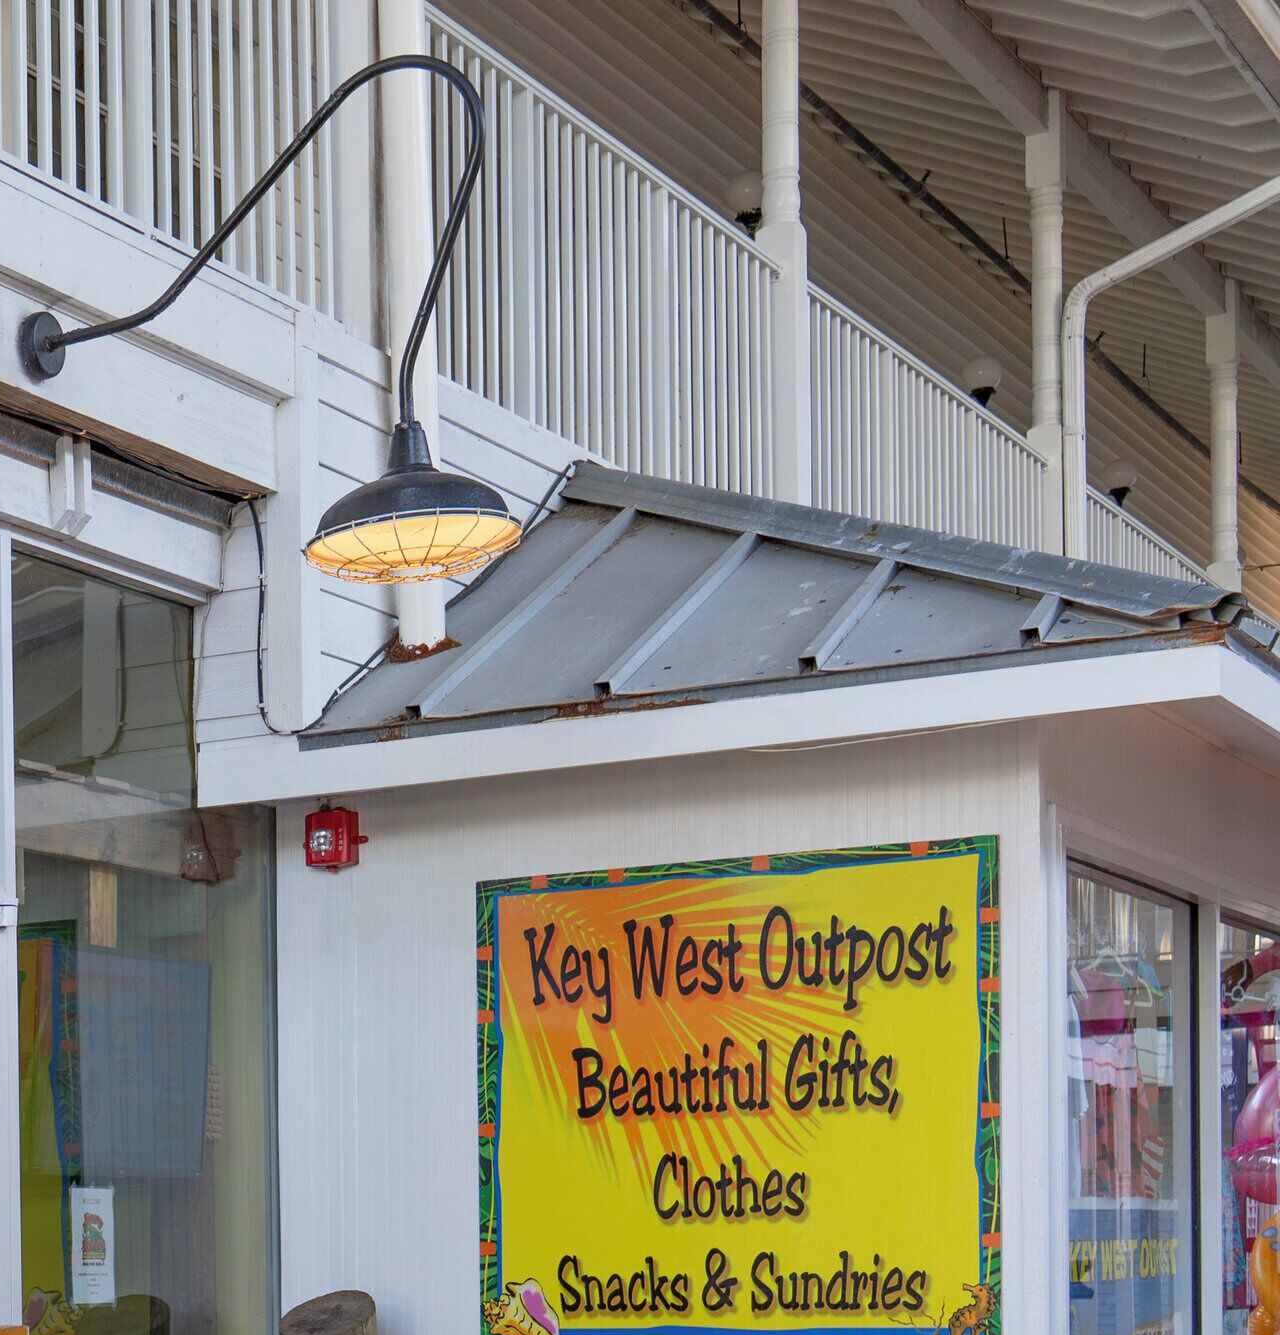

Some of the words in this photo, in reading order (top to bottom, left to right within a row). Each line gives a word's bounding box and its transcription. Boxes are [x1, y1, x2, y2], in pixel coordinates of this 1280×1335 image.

[524, 923, 611, 1023] Key
[623, 914, 743, 999] West
[760, 906, 953, 1011] Outpost
[572, 1038, 769, 1118] Beautiful
[785, 1030, 898, 1114] Gifts,
[654, 1152, 805, 1219] Clothes
[558, 1255, 688, 1313] Snacks
[702, 1248, 737, 1311] &
[751, 1251, 926, 1312] Sundries
[1069, 1240, 1097, 1282] KEY
[1101, 1239, 1138, 1280] WEST
